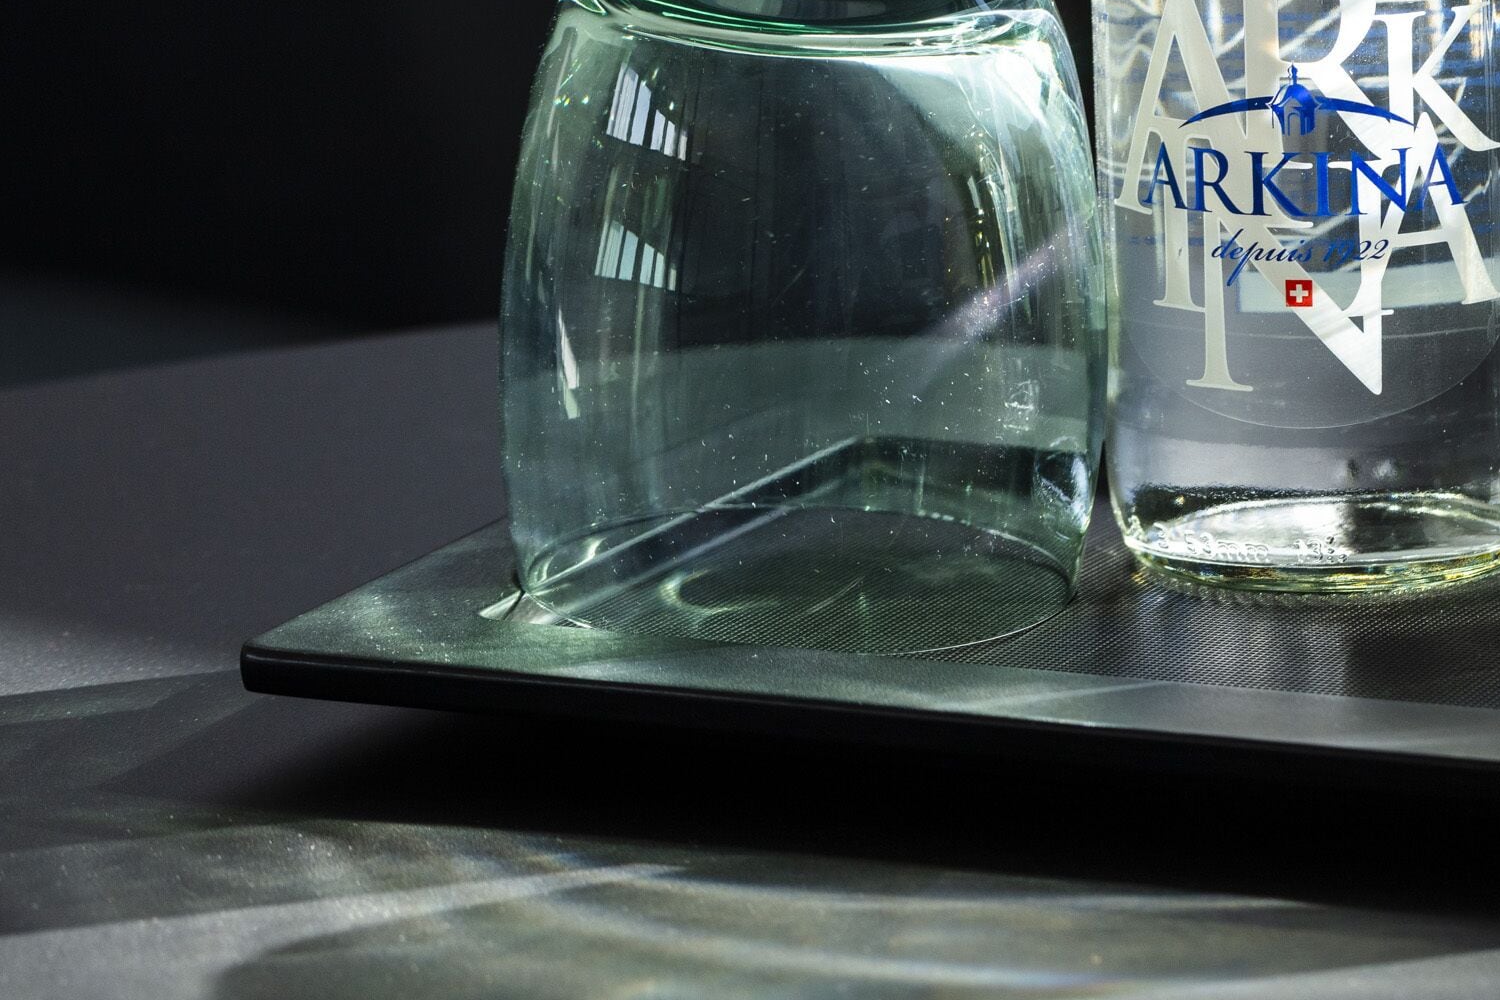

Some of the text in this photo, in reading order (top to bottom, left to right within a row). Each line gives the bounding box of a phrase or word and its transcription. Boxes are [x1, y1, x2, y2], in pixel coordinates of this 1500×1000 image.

[1142, 142, 1466, 217] ARKINA
[1211, 228, 1390, 287] depuis 1922
